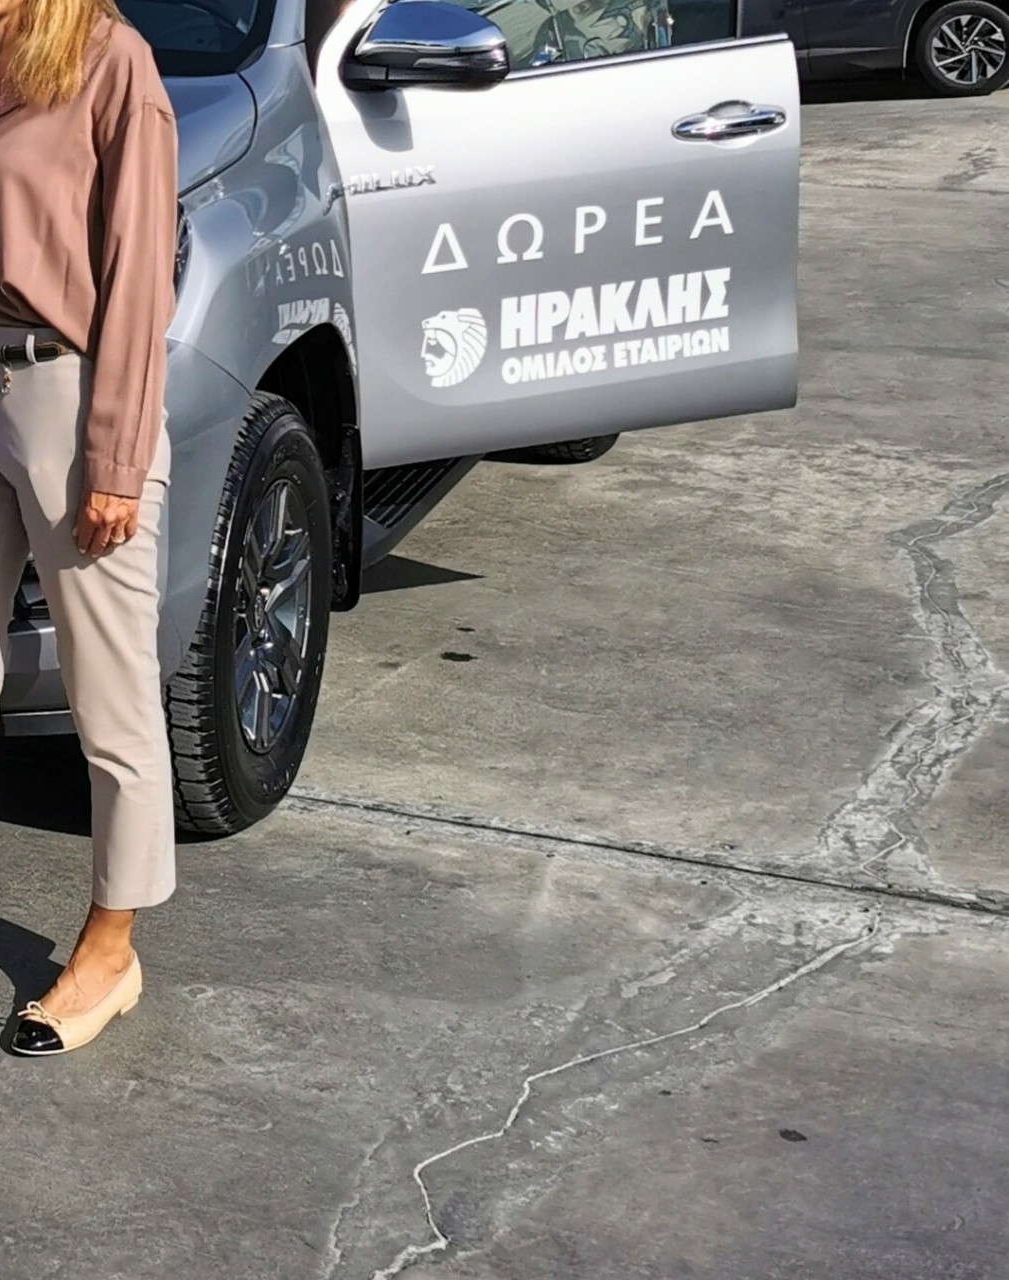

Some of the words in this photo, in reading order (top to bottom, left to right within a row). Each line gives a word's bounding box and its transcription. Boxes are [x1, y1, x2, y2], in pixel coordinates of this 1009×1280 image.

[420, 190, 735, 275] ΔΩΡΕΑ
[500, 267, 732, 350] ΗΡΑΚΛΗΣ
[501, 345, 607, 385] ΟΜΙΛΟΣ
[613, 326, 731, 369] ΕΤΑΙΡΙΩΝ
